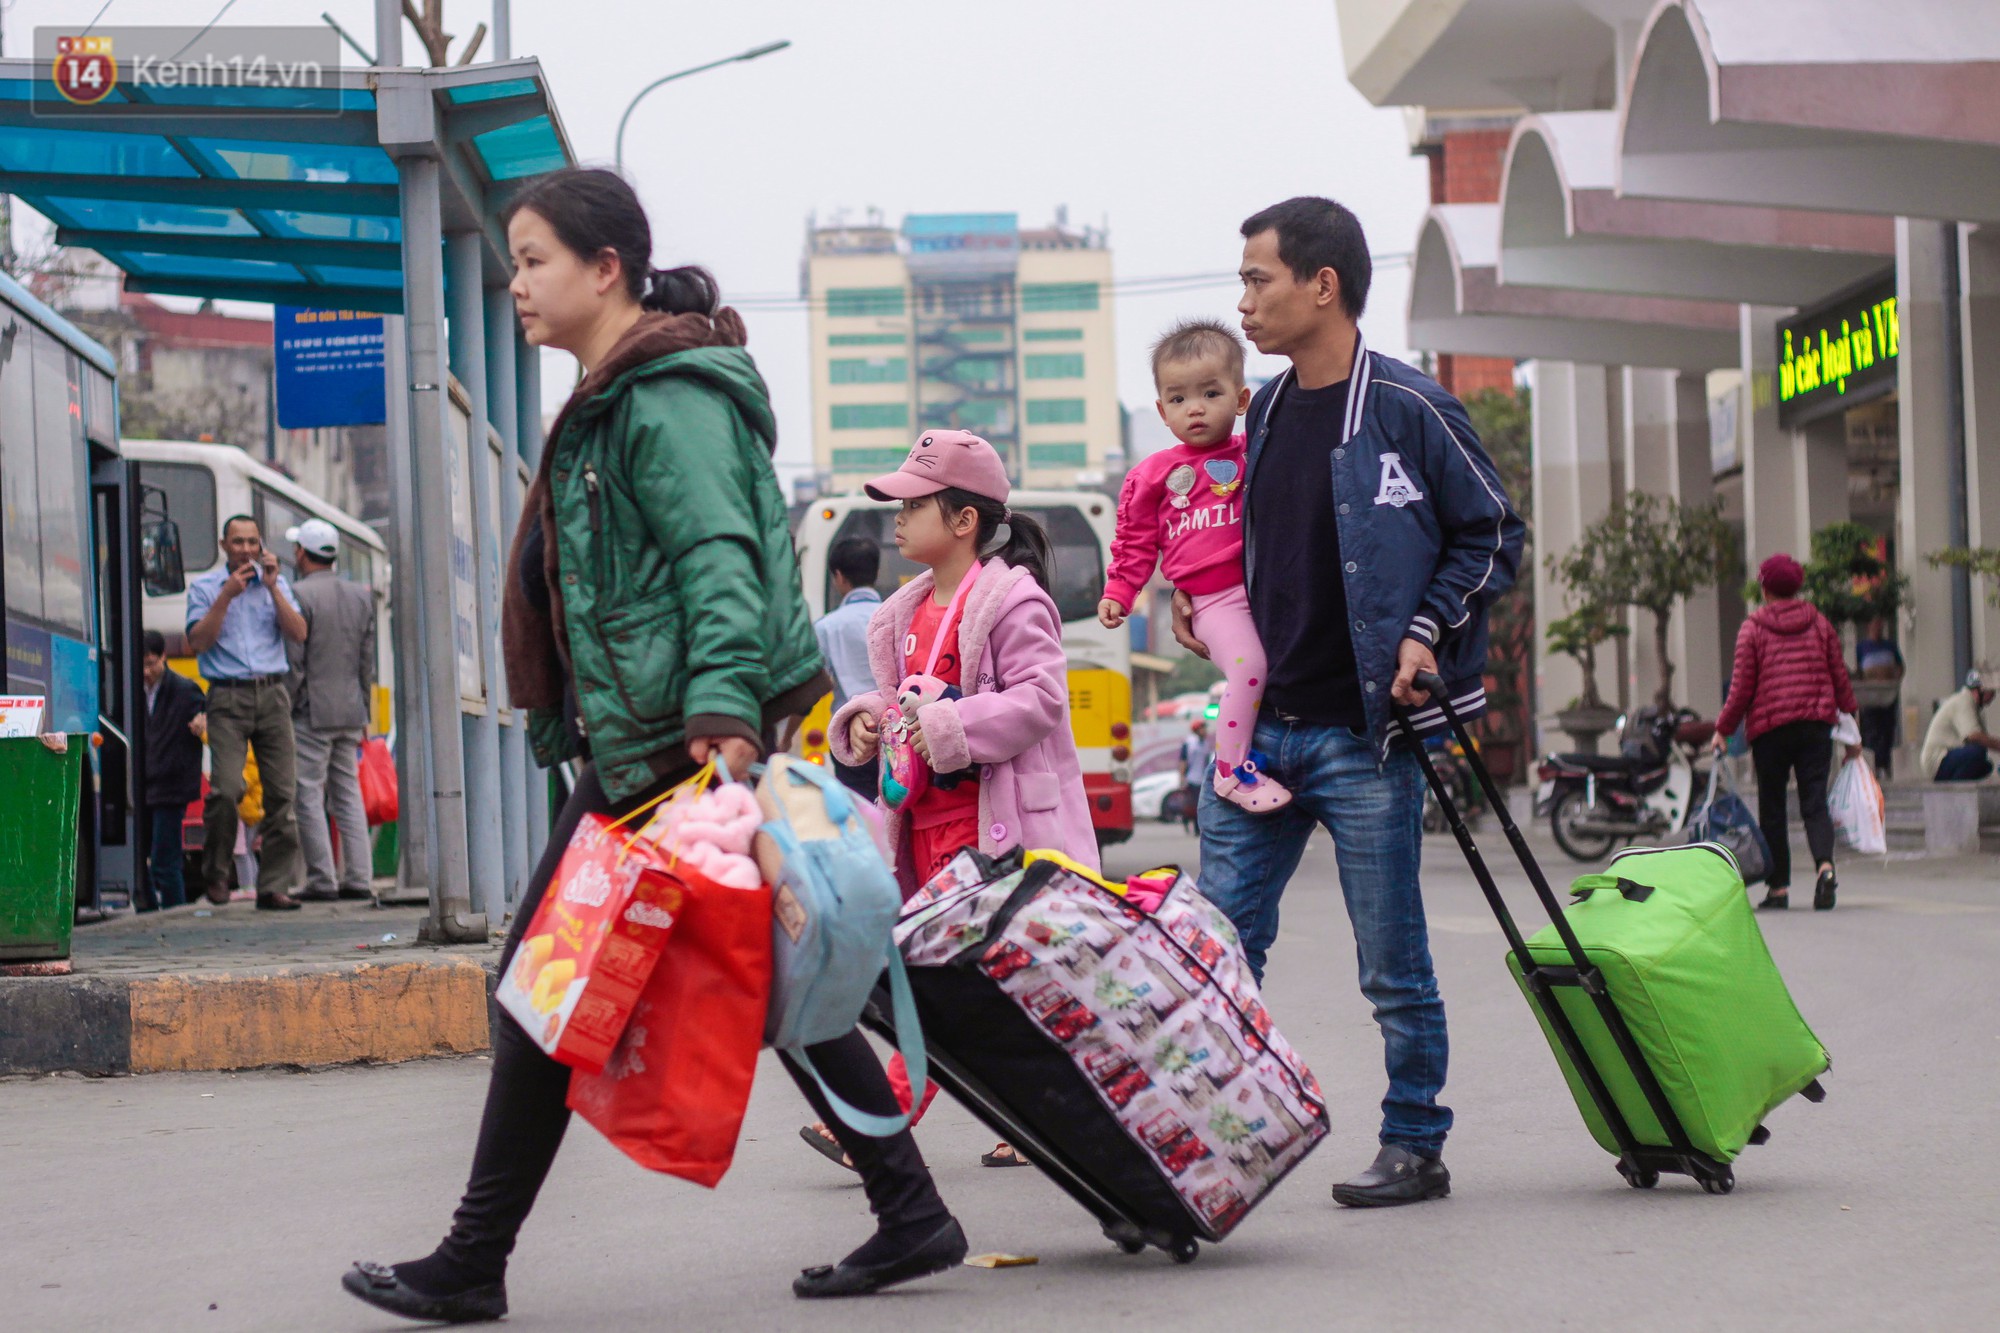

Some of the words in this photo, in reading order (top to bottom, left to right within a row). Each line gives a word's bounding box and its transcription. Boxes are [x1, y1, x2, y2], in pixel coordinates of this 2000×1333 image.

[1795, 336, 1821, 395] các
[1820, 319, 1852, 395] loại
[1851, 310, 1874, 372] và
[1373, 453, 1423, 506] A
